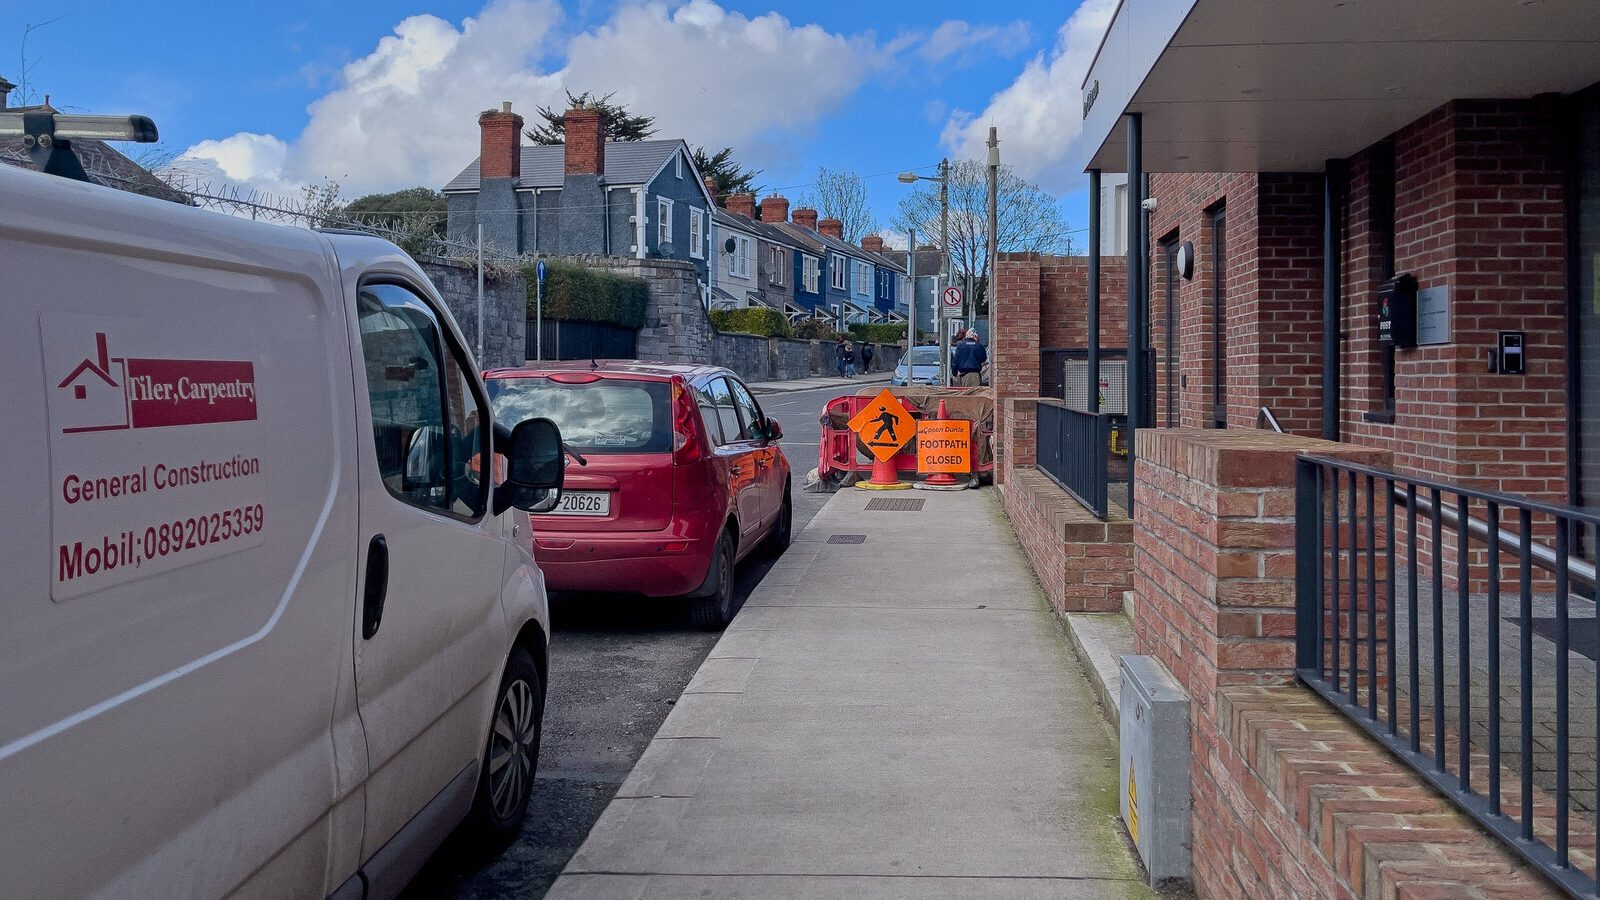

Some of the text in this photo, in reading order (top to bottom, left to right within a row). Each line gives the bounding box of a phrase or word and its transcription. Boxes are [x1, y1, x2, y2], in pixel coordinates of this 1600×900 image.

[1380, 321, 1392, 330] POST
[129, 375, 255, 404] Tiler,Carpentry
[920, 440, 968, 449] FOOTPATH
[925, 455, 963, 465] CLOSED
[63, 454, 260, 504] General Construction
[59, 503, 264, 582] Mobil;0892025359
